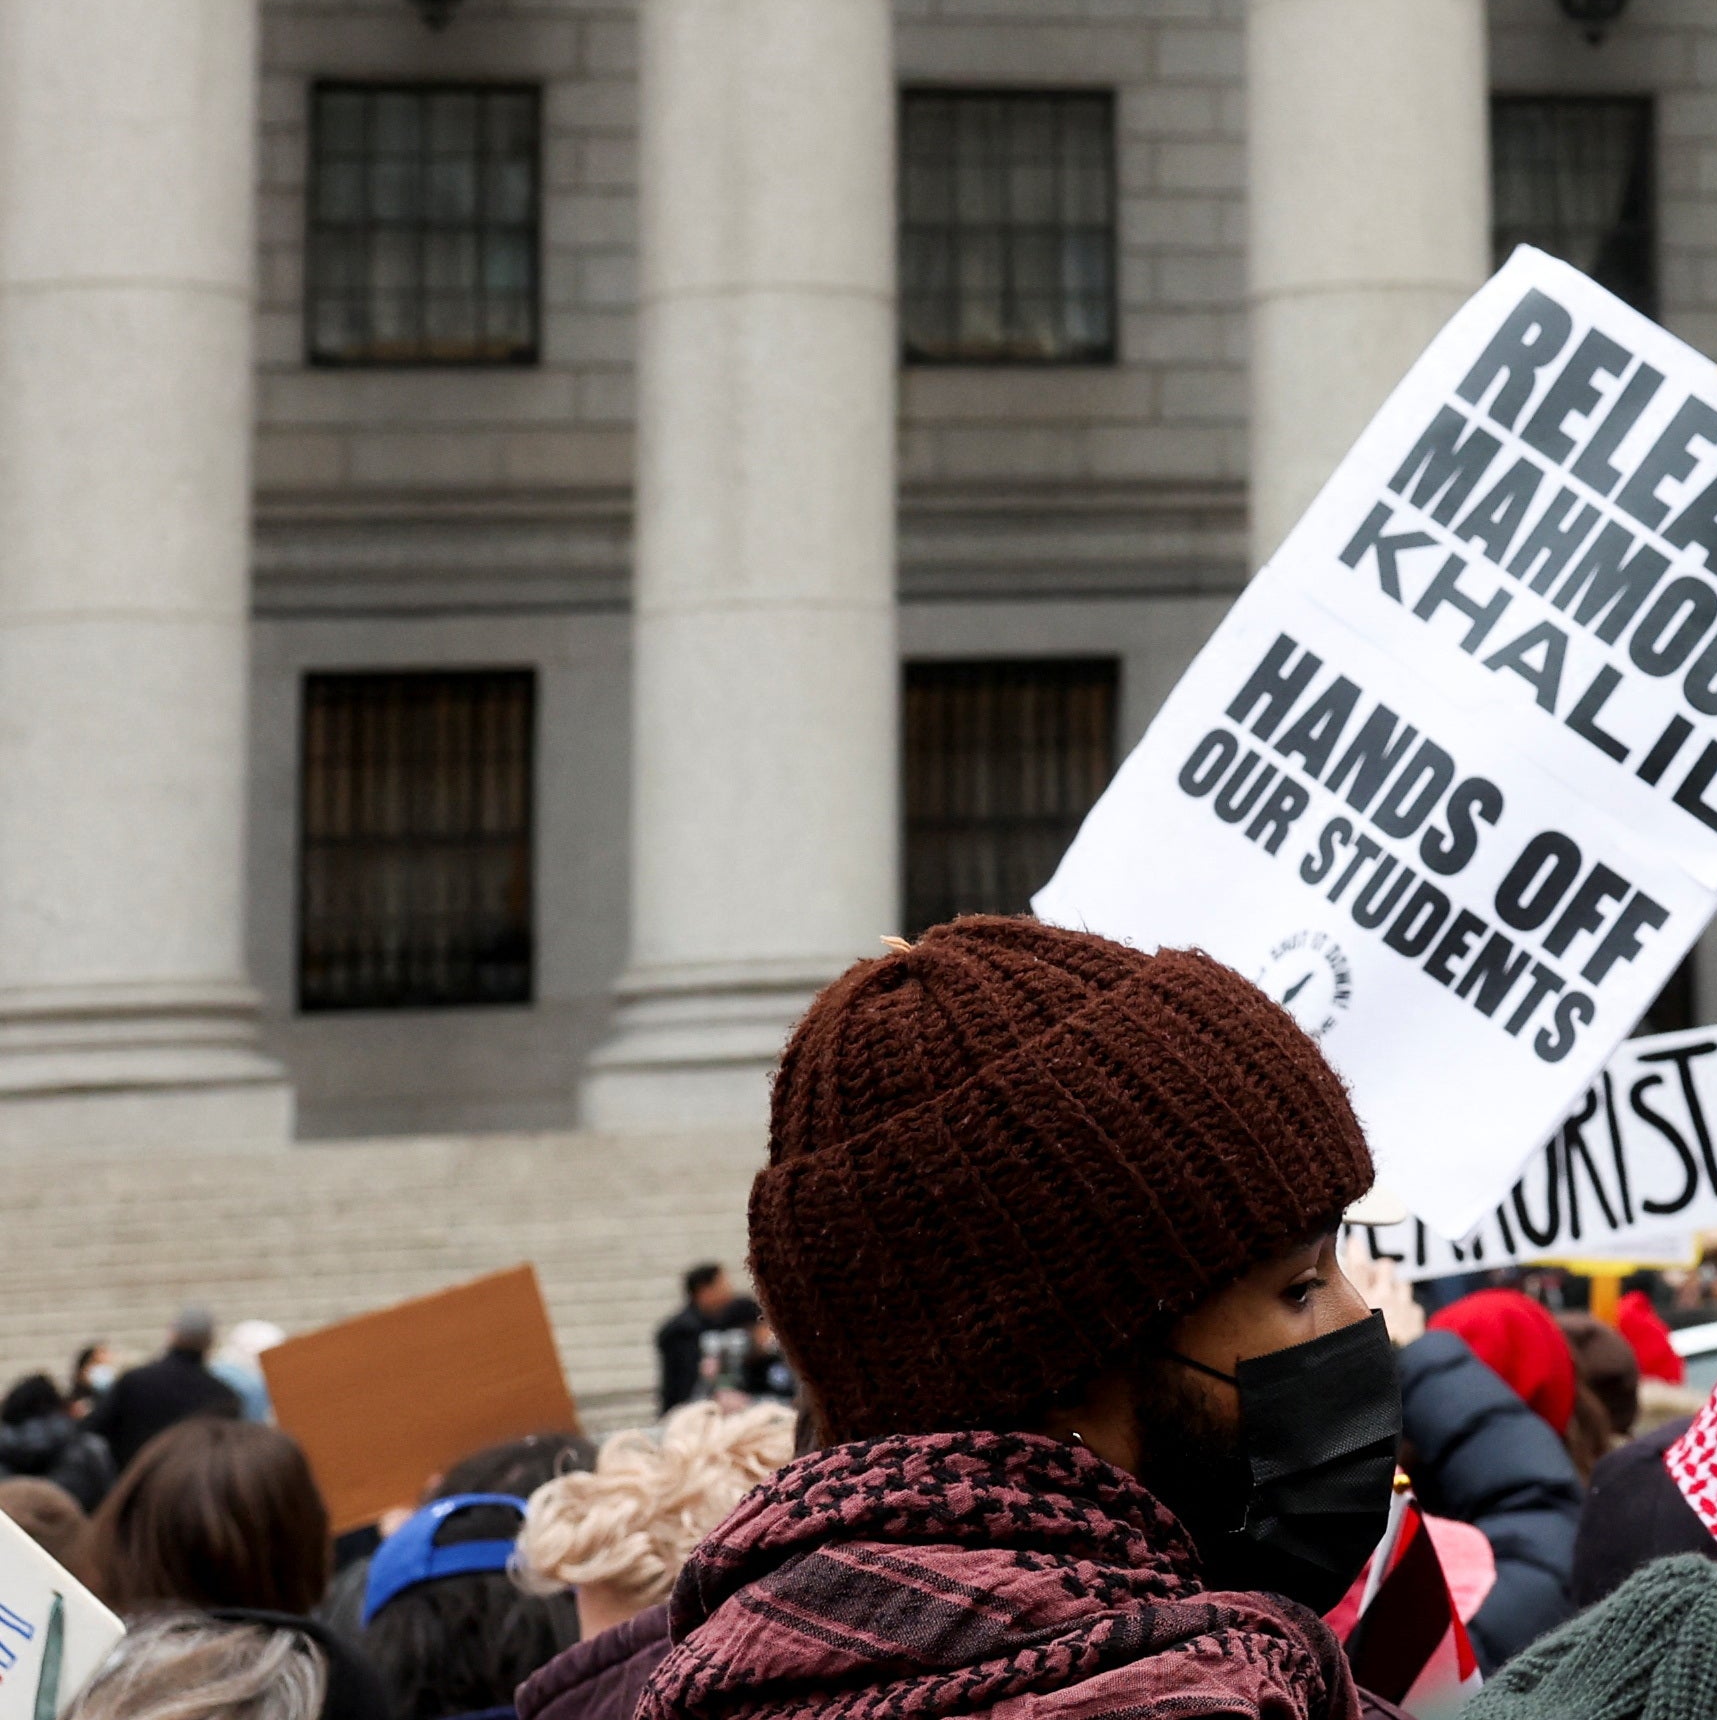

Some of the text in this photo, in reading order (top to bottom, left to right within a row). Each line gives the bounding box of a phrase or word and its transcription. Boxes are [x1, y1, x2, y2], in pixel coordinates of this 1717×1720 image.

[1177, 728, 1596, 1063] OUR STUDENTS
[1224, 631, 1671, 986] HANDS OFF
